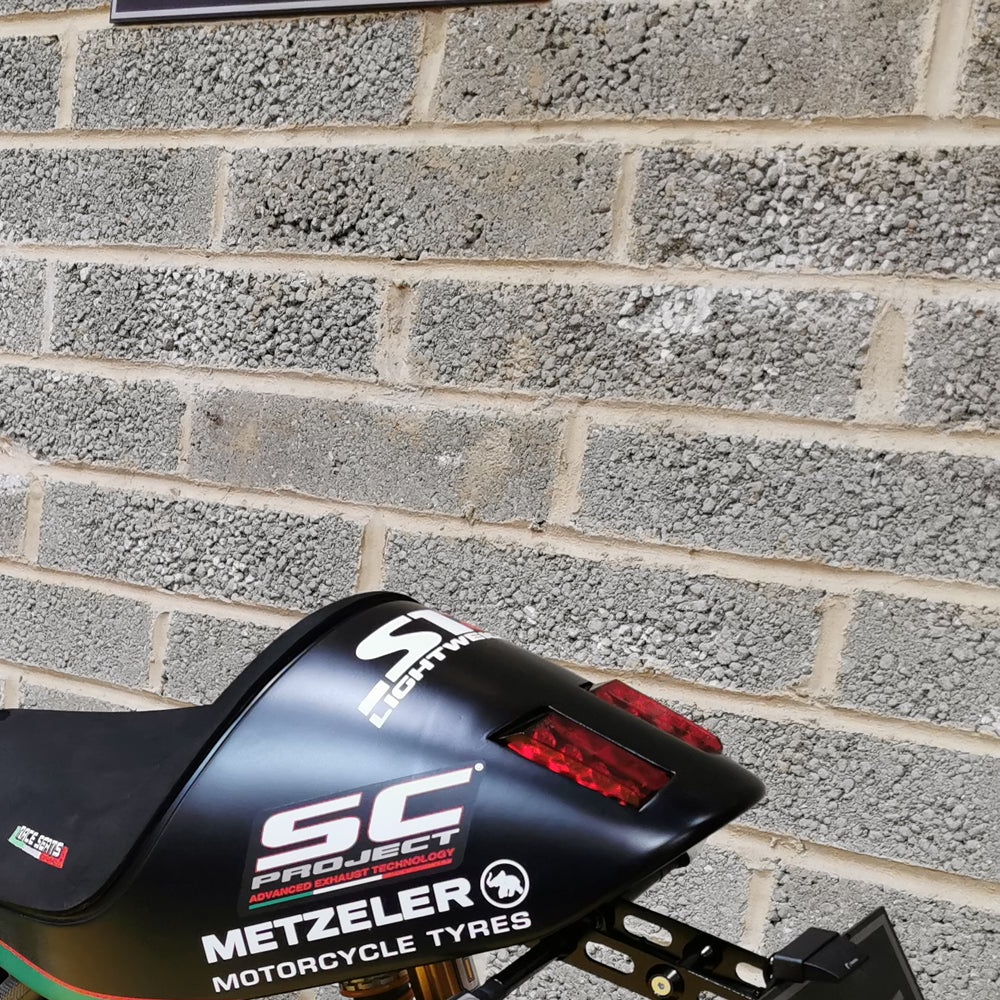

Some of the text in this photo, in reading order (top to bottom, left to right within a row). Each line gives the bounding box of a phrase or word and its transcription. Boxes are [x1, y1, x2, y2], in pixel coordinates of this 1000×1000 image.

[250, 828, 461, 890] PROJECT
[254, 767, 474, 874] SC
[249, 847, 456, 904] ADVANCED EXHAUST TECHNOLOGY
[201, 876, 475, 964] METZELER
[211, 910, 533, 993] MOTORCYCLE TYRES
